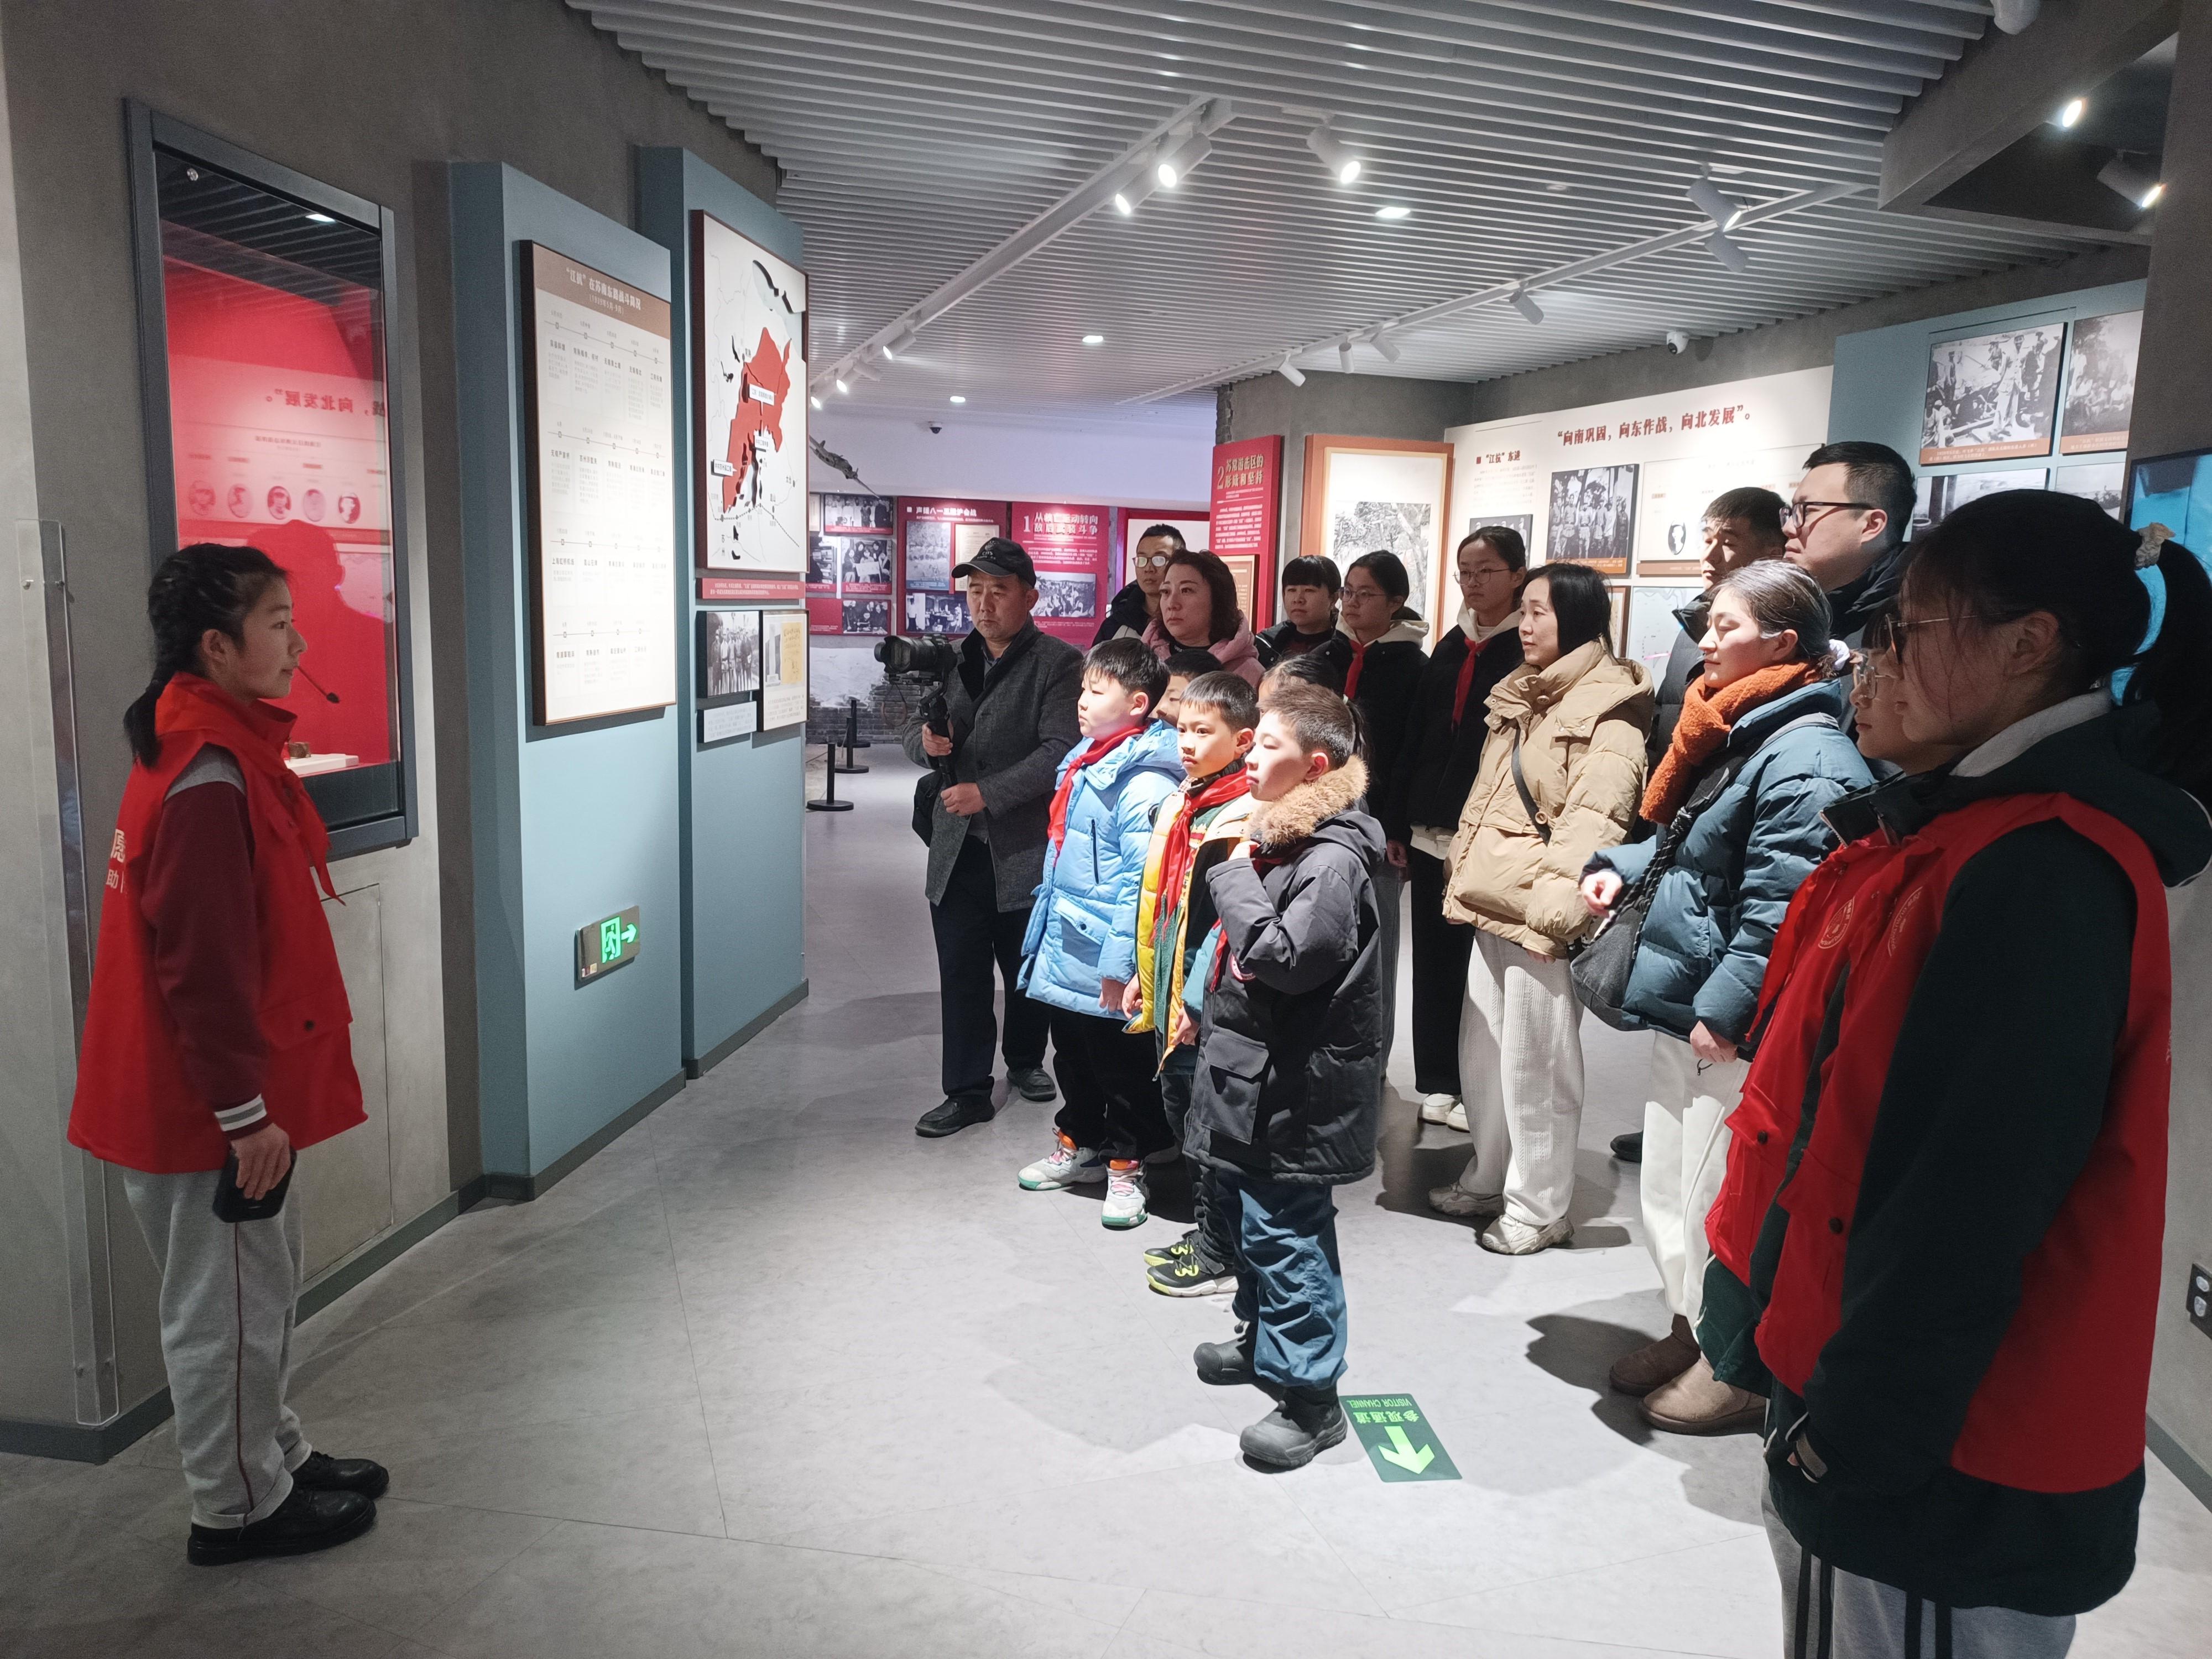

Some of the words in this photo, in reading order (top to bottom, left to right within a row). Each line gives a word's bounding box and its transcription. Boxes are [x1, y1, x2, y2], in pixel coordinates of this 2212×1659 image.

[1557, 405, 1751, 446] “向南巩固，向东作战，向北发展”。
[1225, 454, 1264, 473] 苏常游击区的
[1217, 466, 1224, 489] 2
[1225, 470, 1264, 488] 形成和坚持
[1024, 515, 1031, 533] 1
[1347, 1399, 1381, 1408] CHANNEL
[1381, 1398, 1412, 1407] VISITOR
[1353, 1410, 1420, 1424] 参观通道
